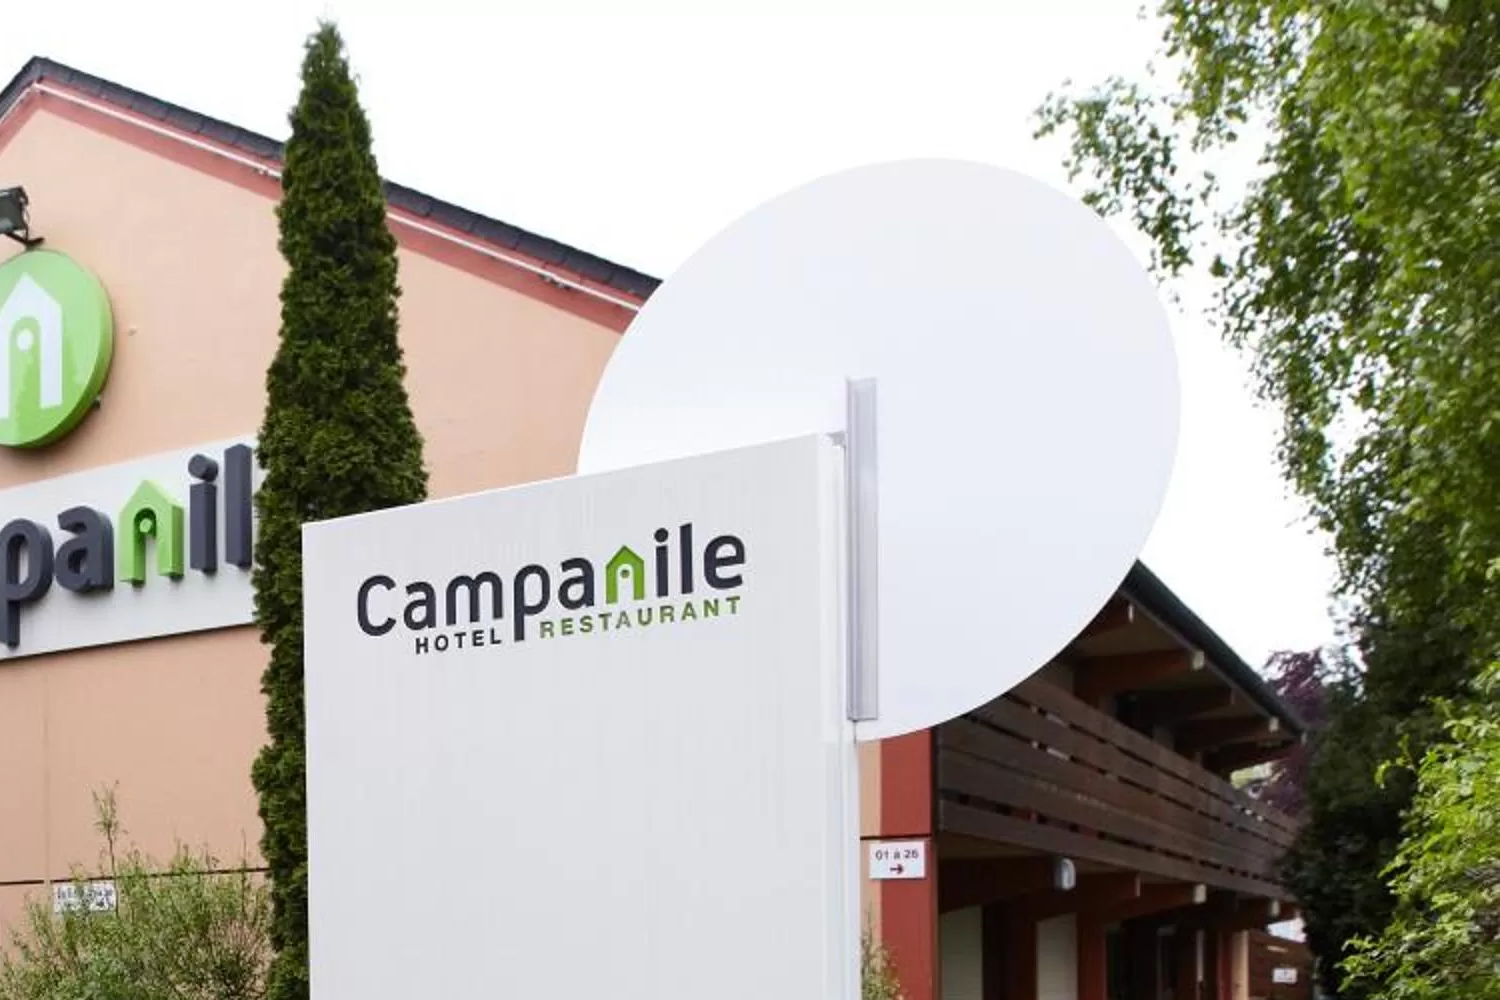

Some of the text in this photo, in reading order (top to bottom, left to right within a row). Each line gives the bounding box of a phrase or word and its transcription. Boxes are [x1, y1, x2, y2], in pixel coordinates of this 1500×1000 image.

[356, 521, 746, 643] Campanile
[414, 595, 742, 656] HOTEL RESTAURANT
[875, 849, 890, 861] 01
